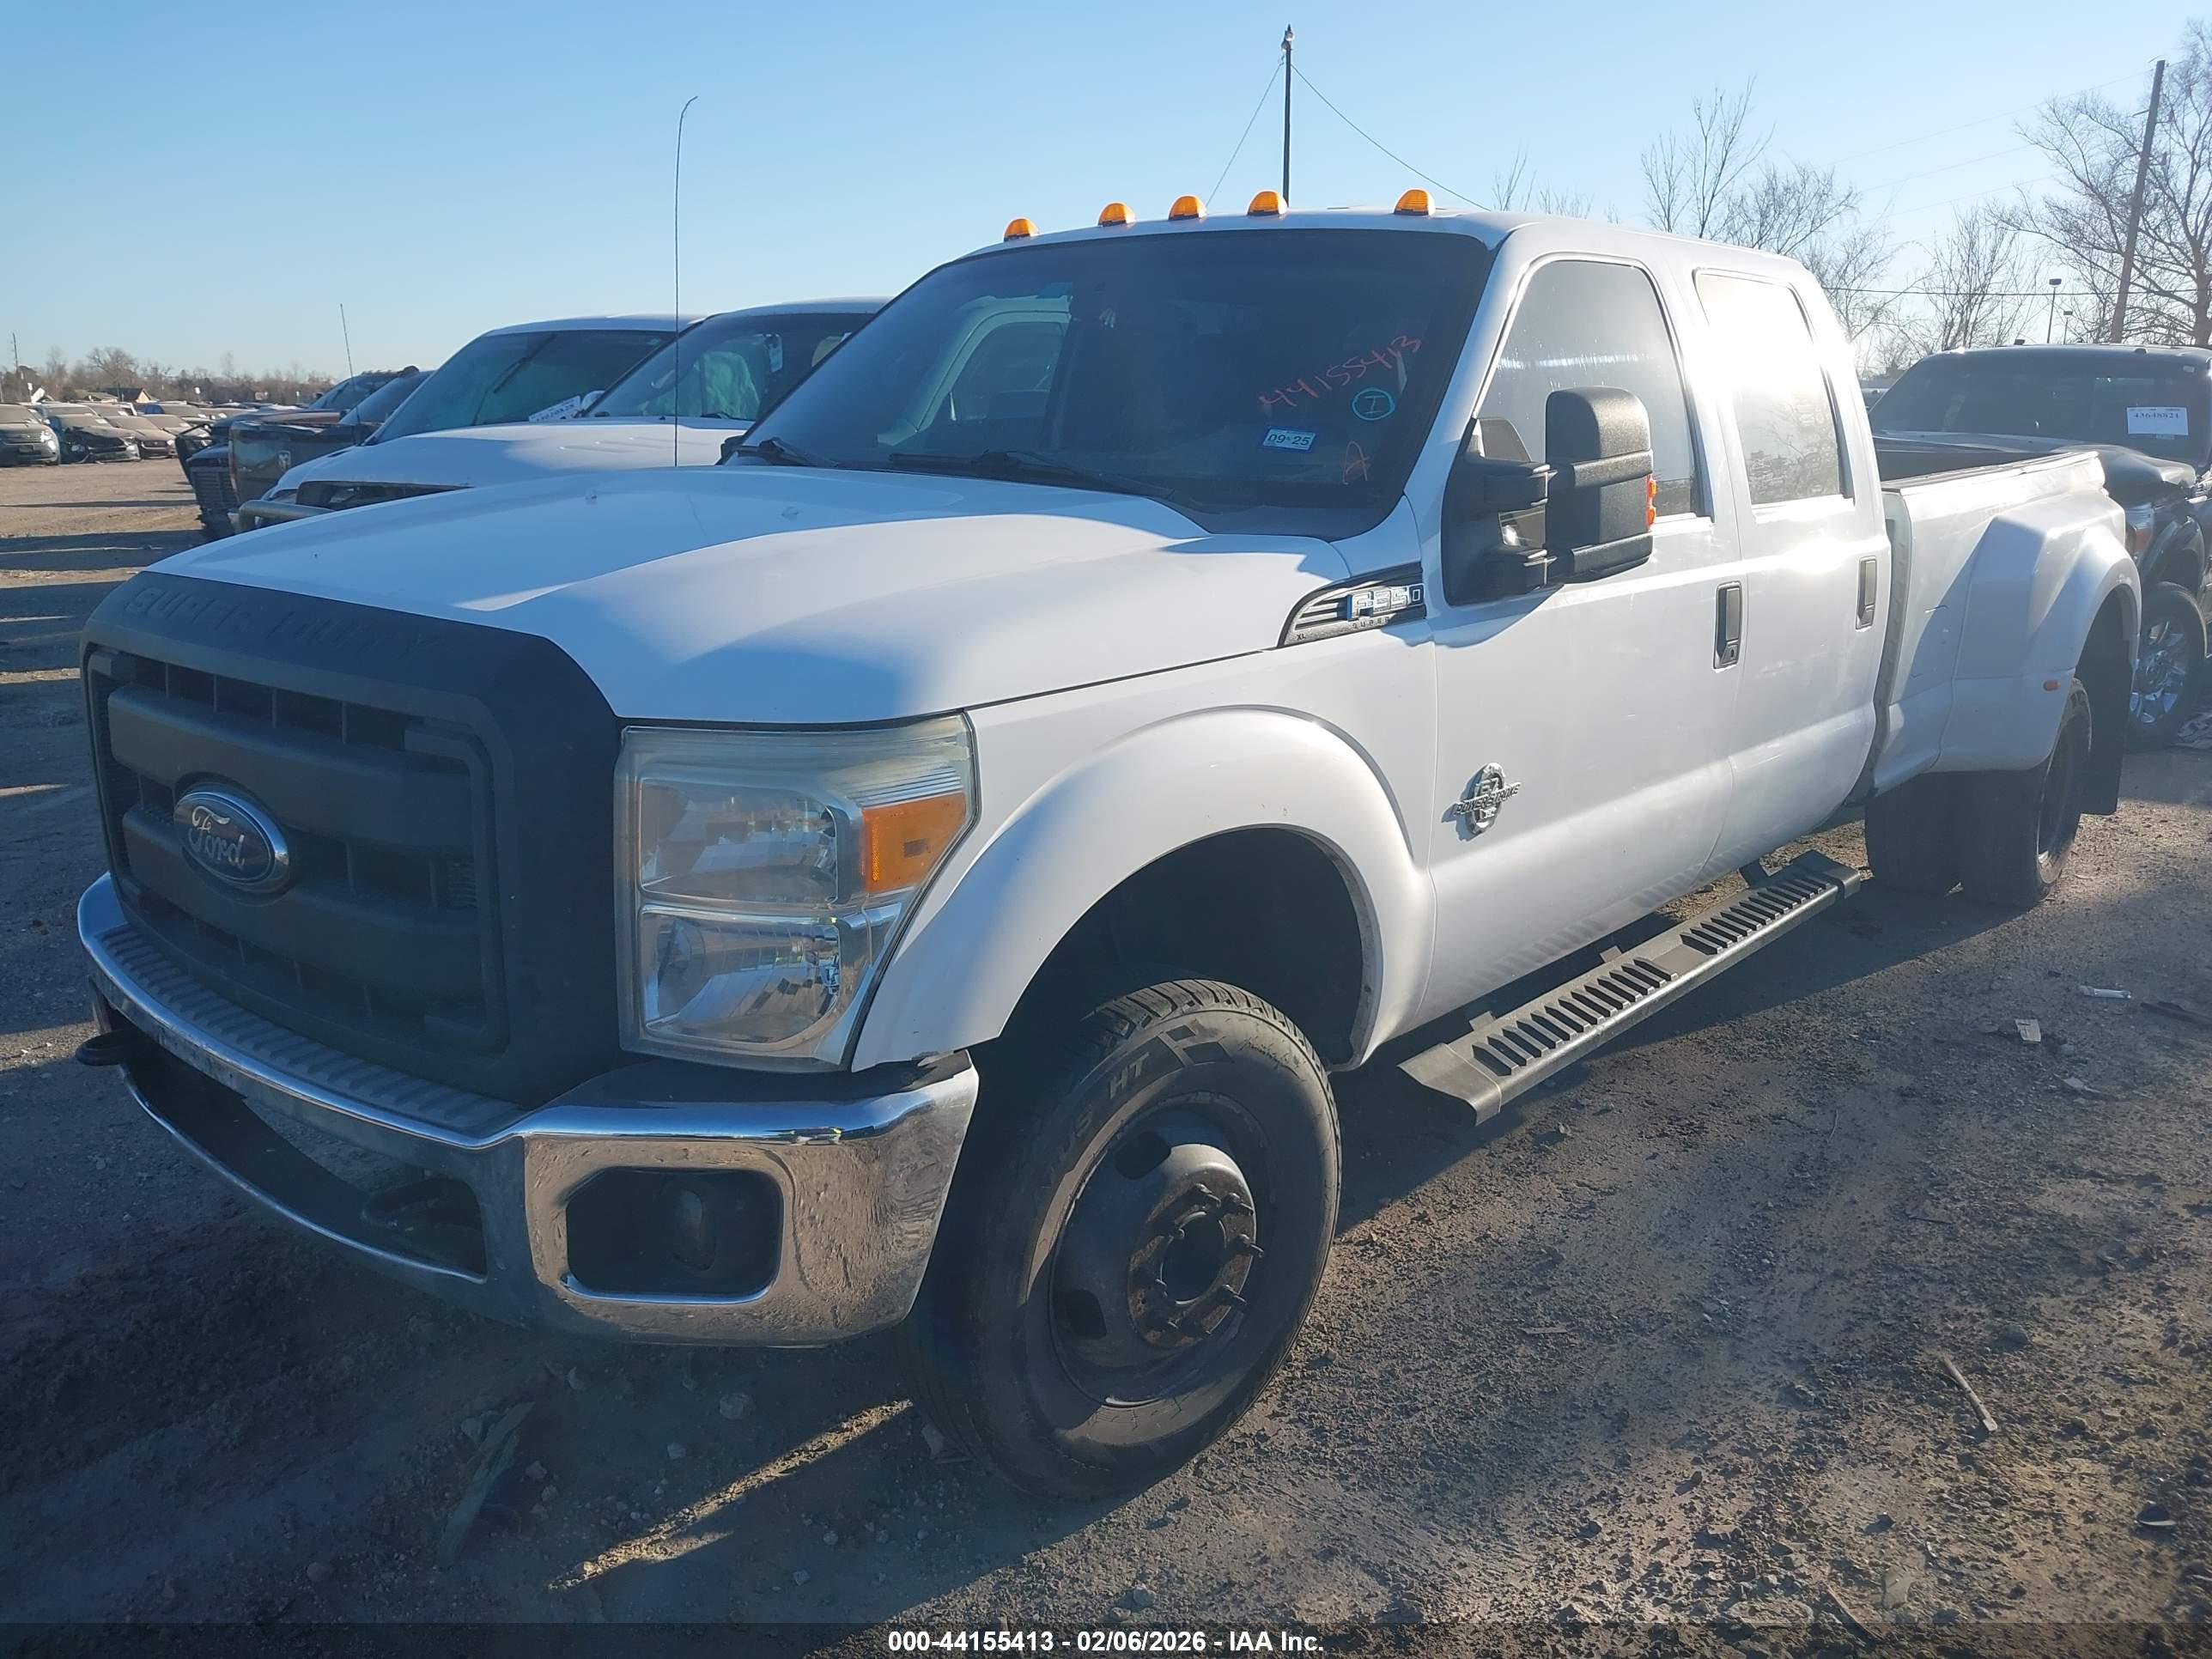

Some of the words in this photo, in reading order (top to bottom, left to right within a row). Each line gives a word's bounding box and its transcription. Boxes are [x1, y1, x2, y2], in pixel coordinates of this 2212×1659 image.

[1291, 435, 1312, 447] 25
[186, 805, 246, 868] Ford
[1108, 1049, 1152, 1099] HT
